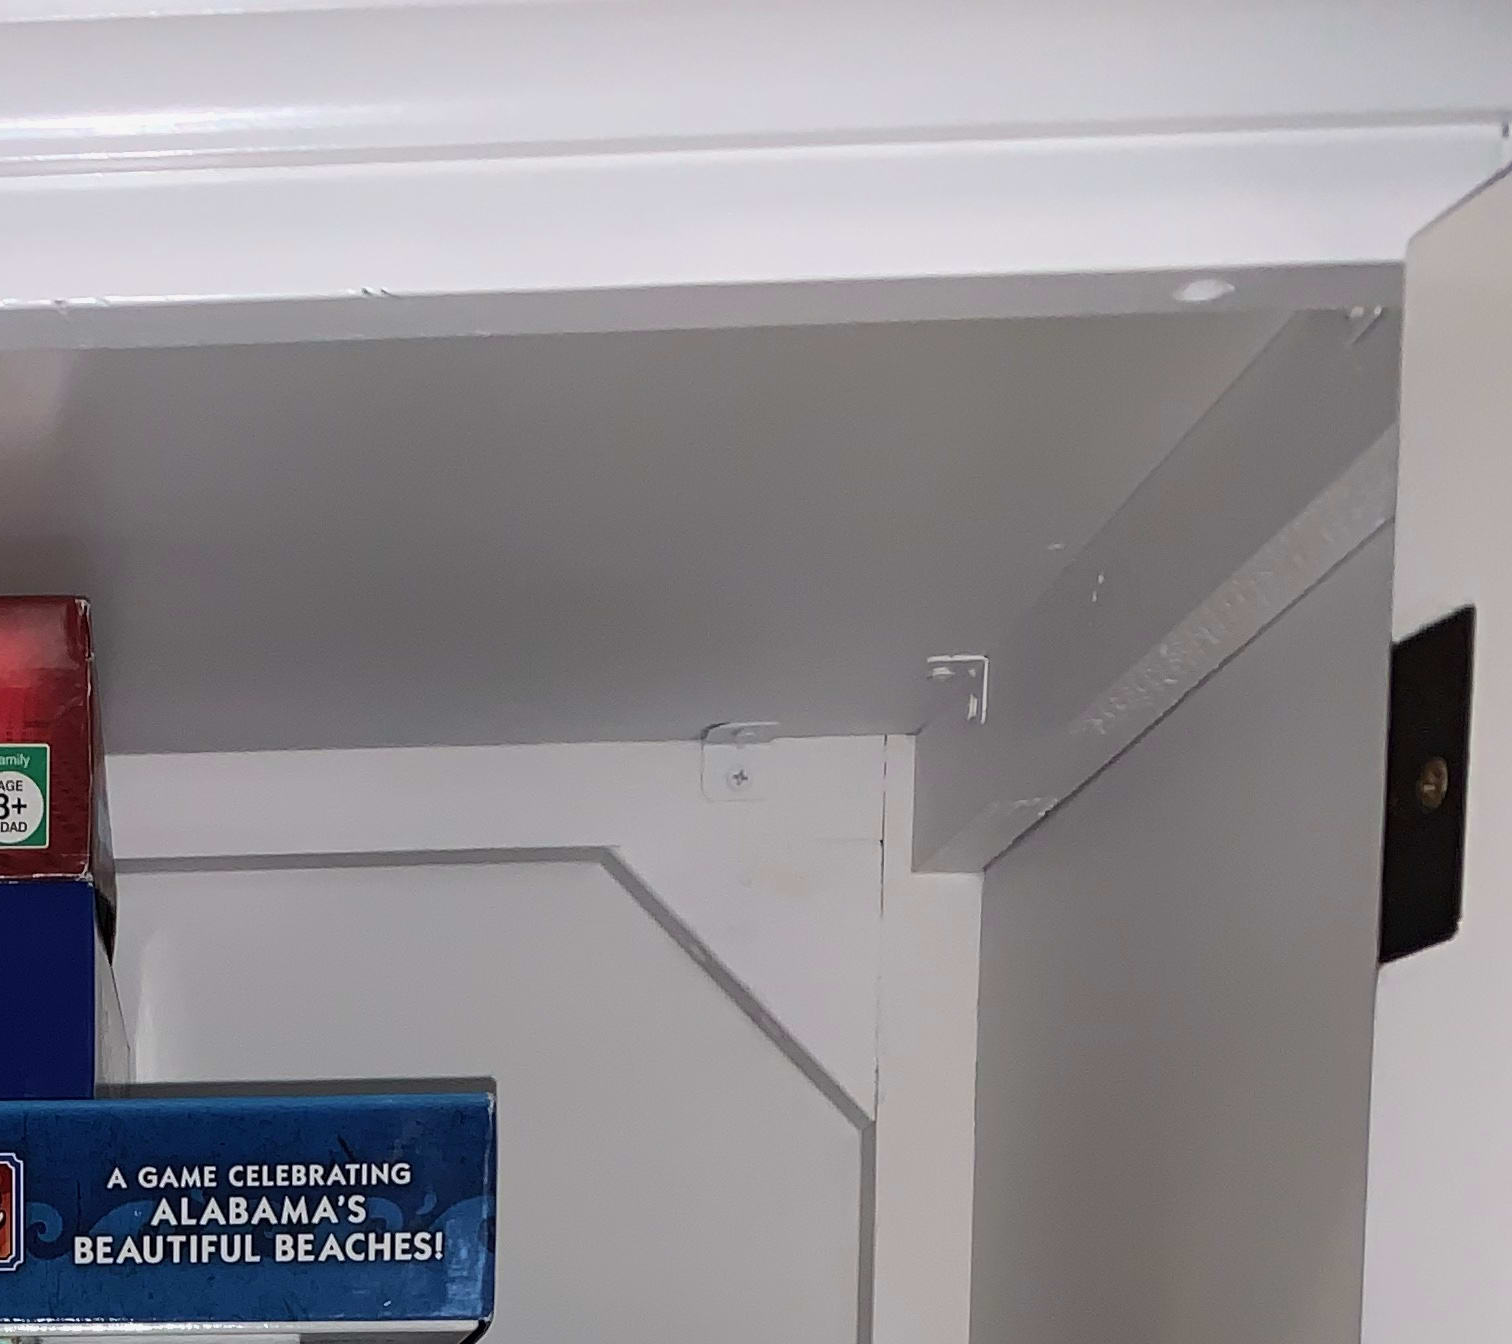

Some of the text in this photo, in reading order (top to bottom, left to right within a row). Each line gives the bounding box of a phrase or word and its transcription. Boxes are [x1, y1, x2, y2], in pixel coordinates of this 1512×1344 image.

[106, 1162, 412, 1189] A GAME CELEBRATING
[150, 1194, 366, 1227] ALABAMA'S
[73, 1231, 445, 1265] BEAUTIFUL BEACHES!
